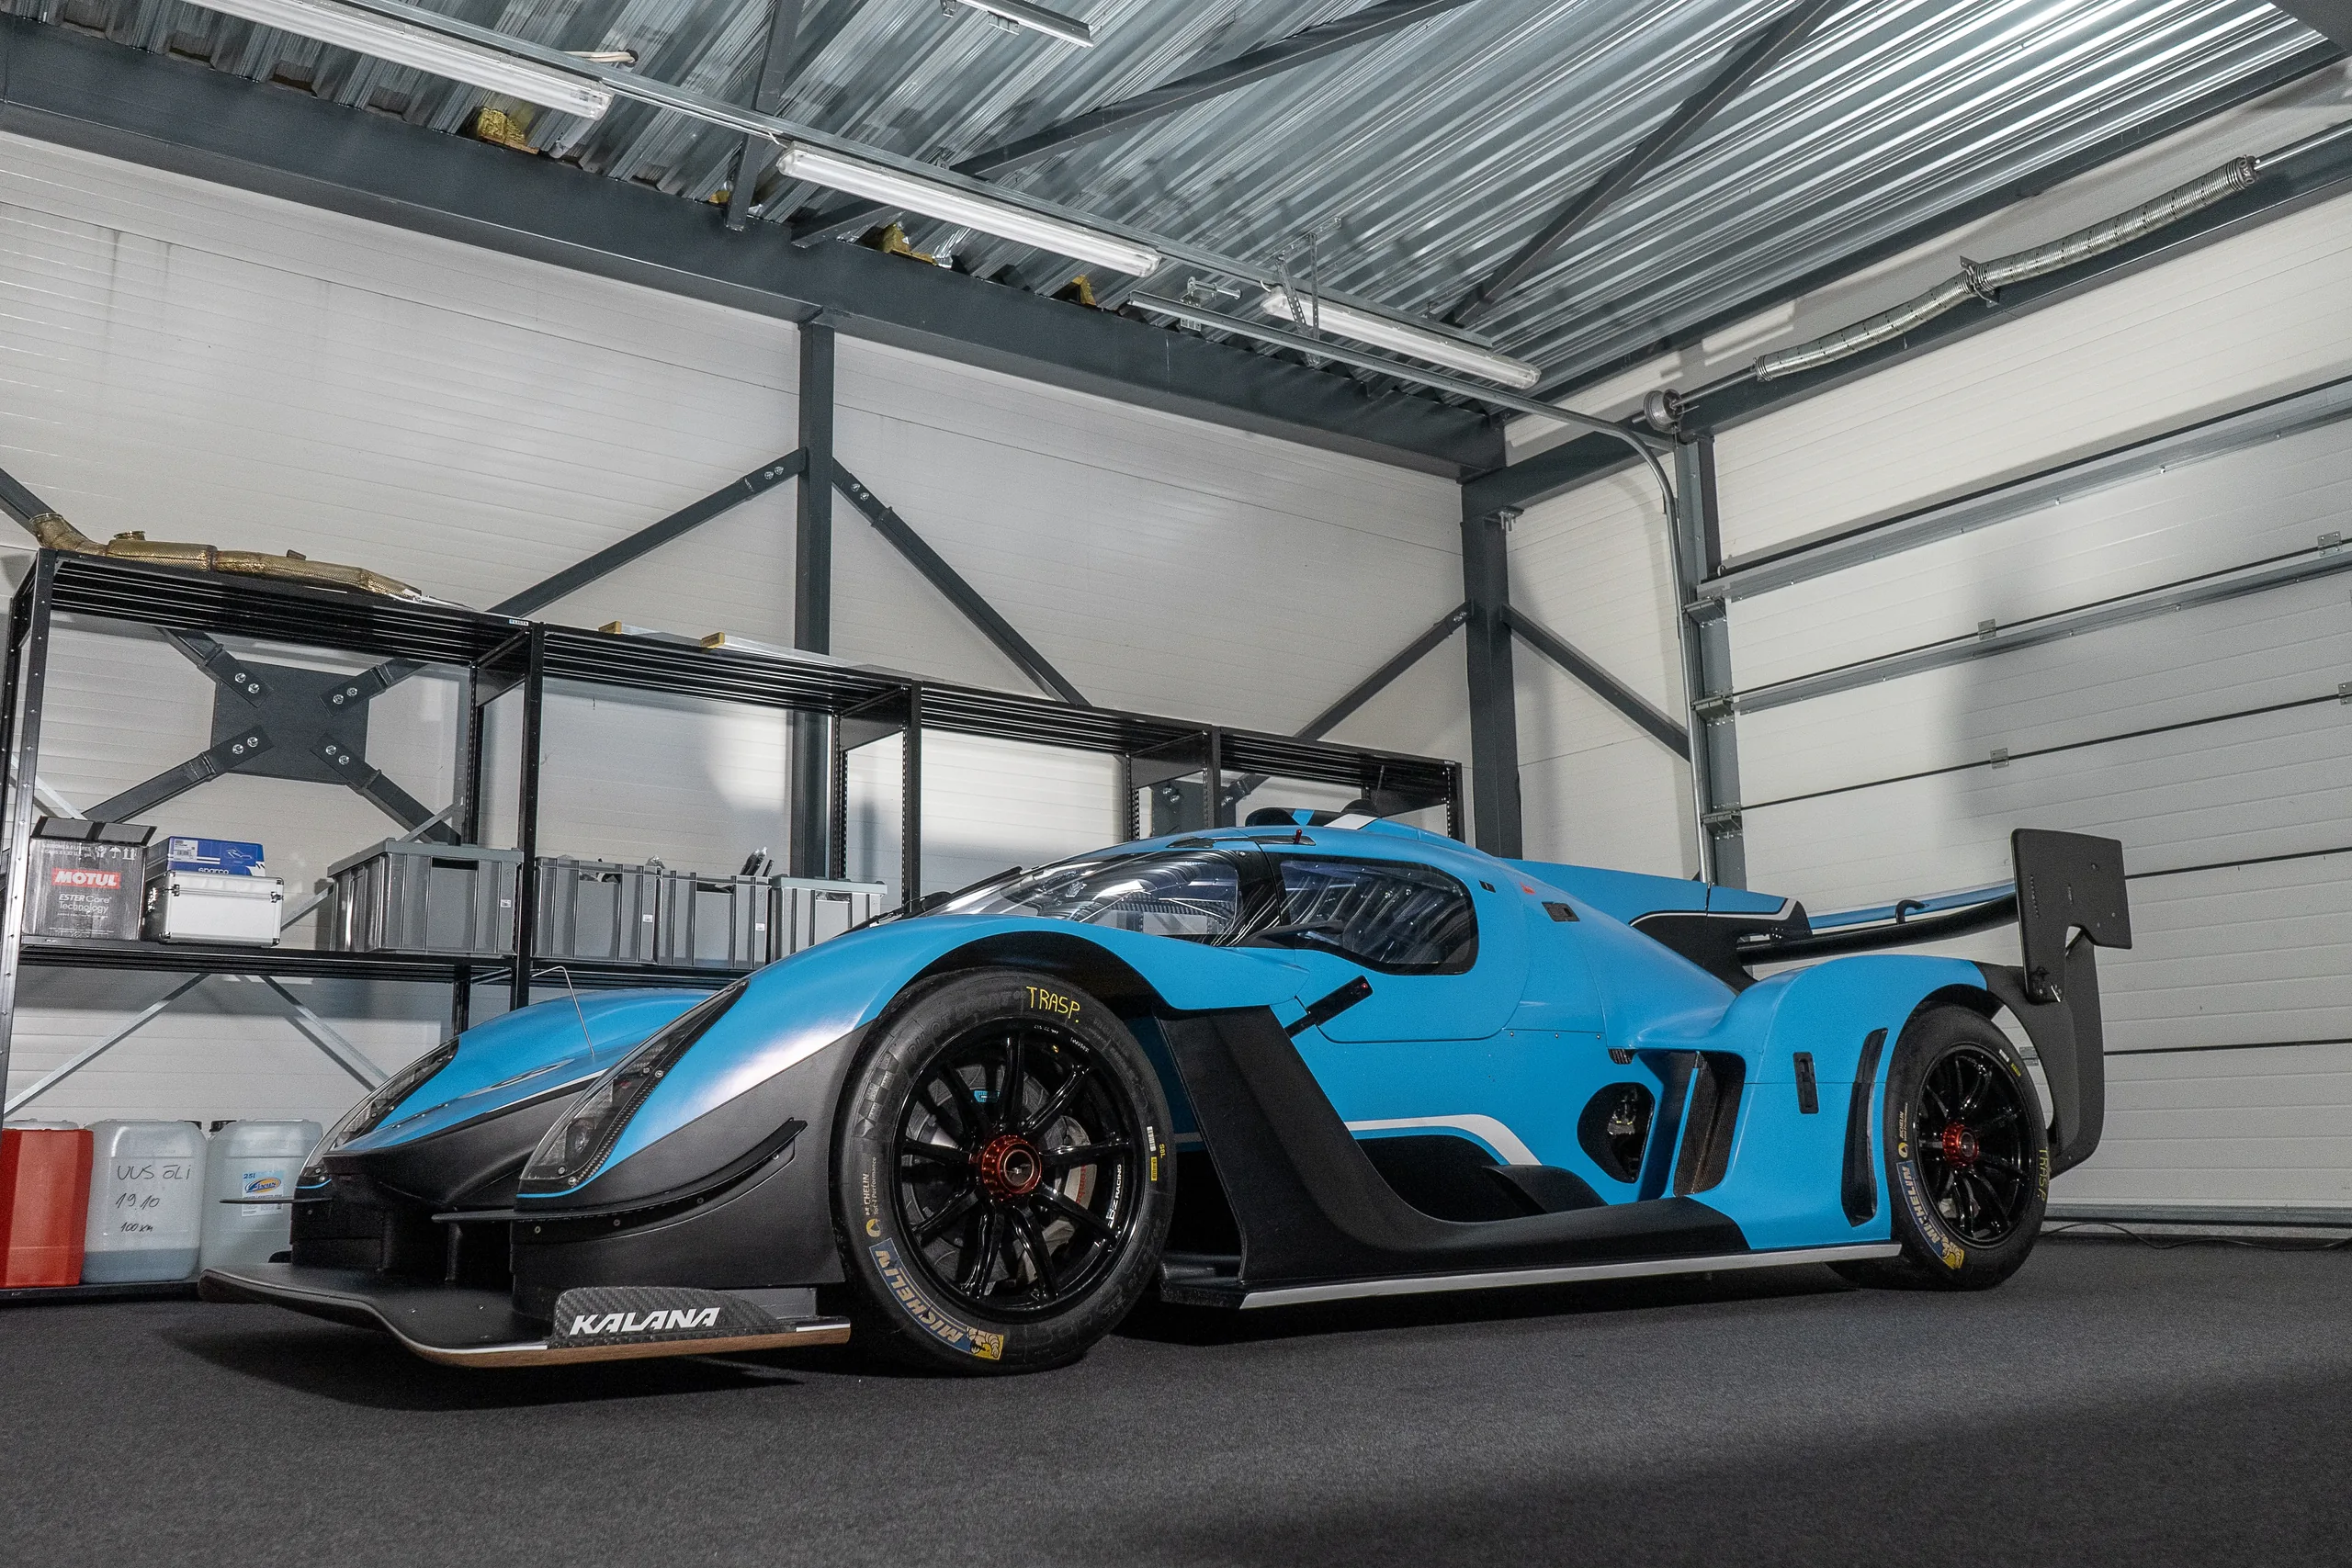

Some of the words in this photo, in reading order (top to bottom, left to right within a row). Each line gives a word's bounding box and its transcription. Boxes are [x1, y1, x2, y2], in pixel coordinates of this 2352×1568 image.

[55, 870, 118, 886] MOTUL
[59, 894, 85, 902] ESTER
[59, 901, 109, 915] Technology
[1025, 986, 1080, 1022] TRASP.
[117, 1165, 154, 1180] UUS
[115, 1192, 161, 1211] 19.10
[875, 1249, 964, 1344] MICHELIN
[570, 1307, 720, 1336] KALANA
